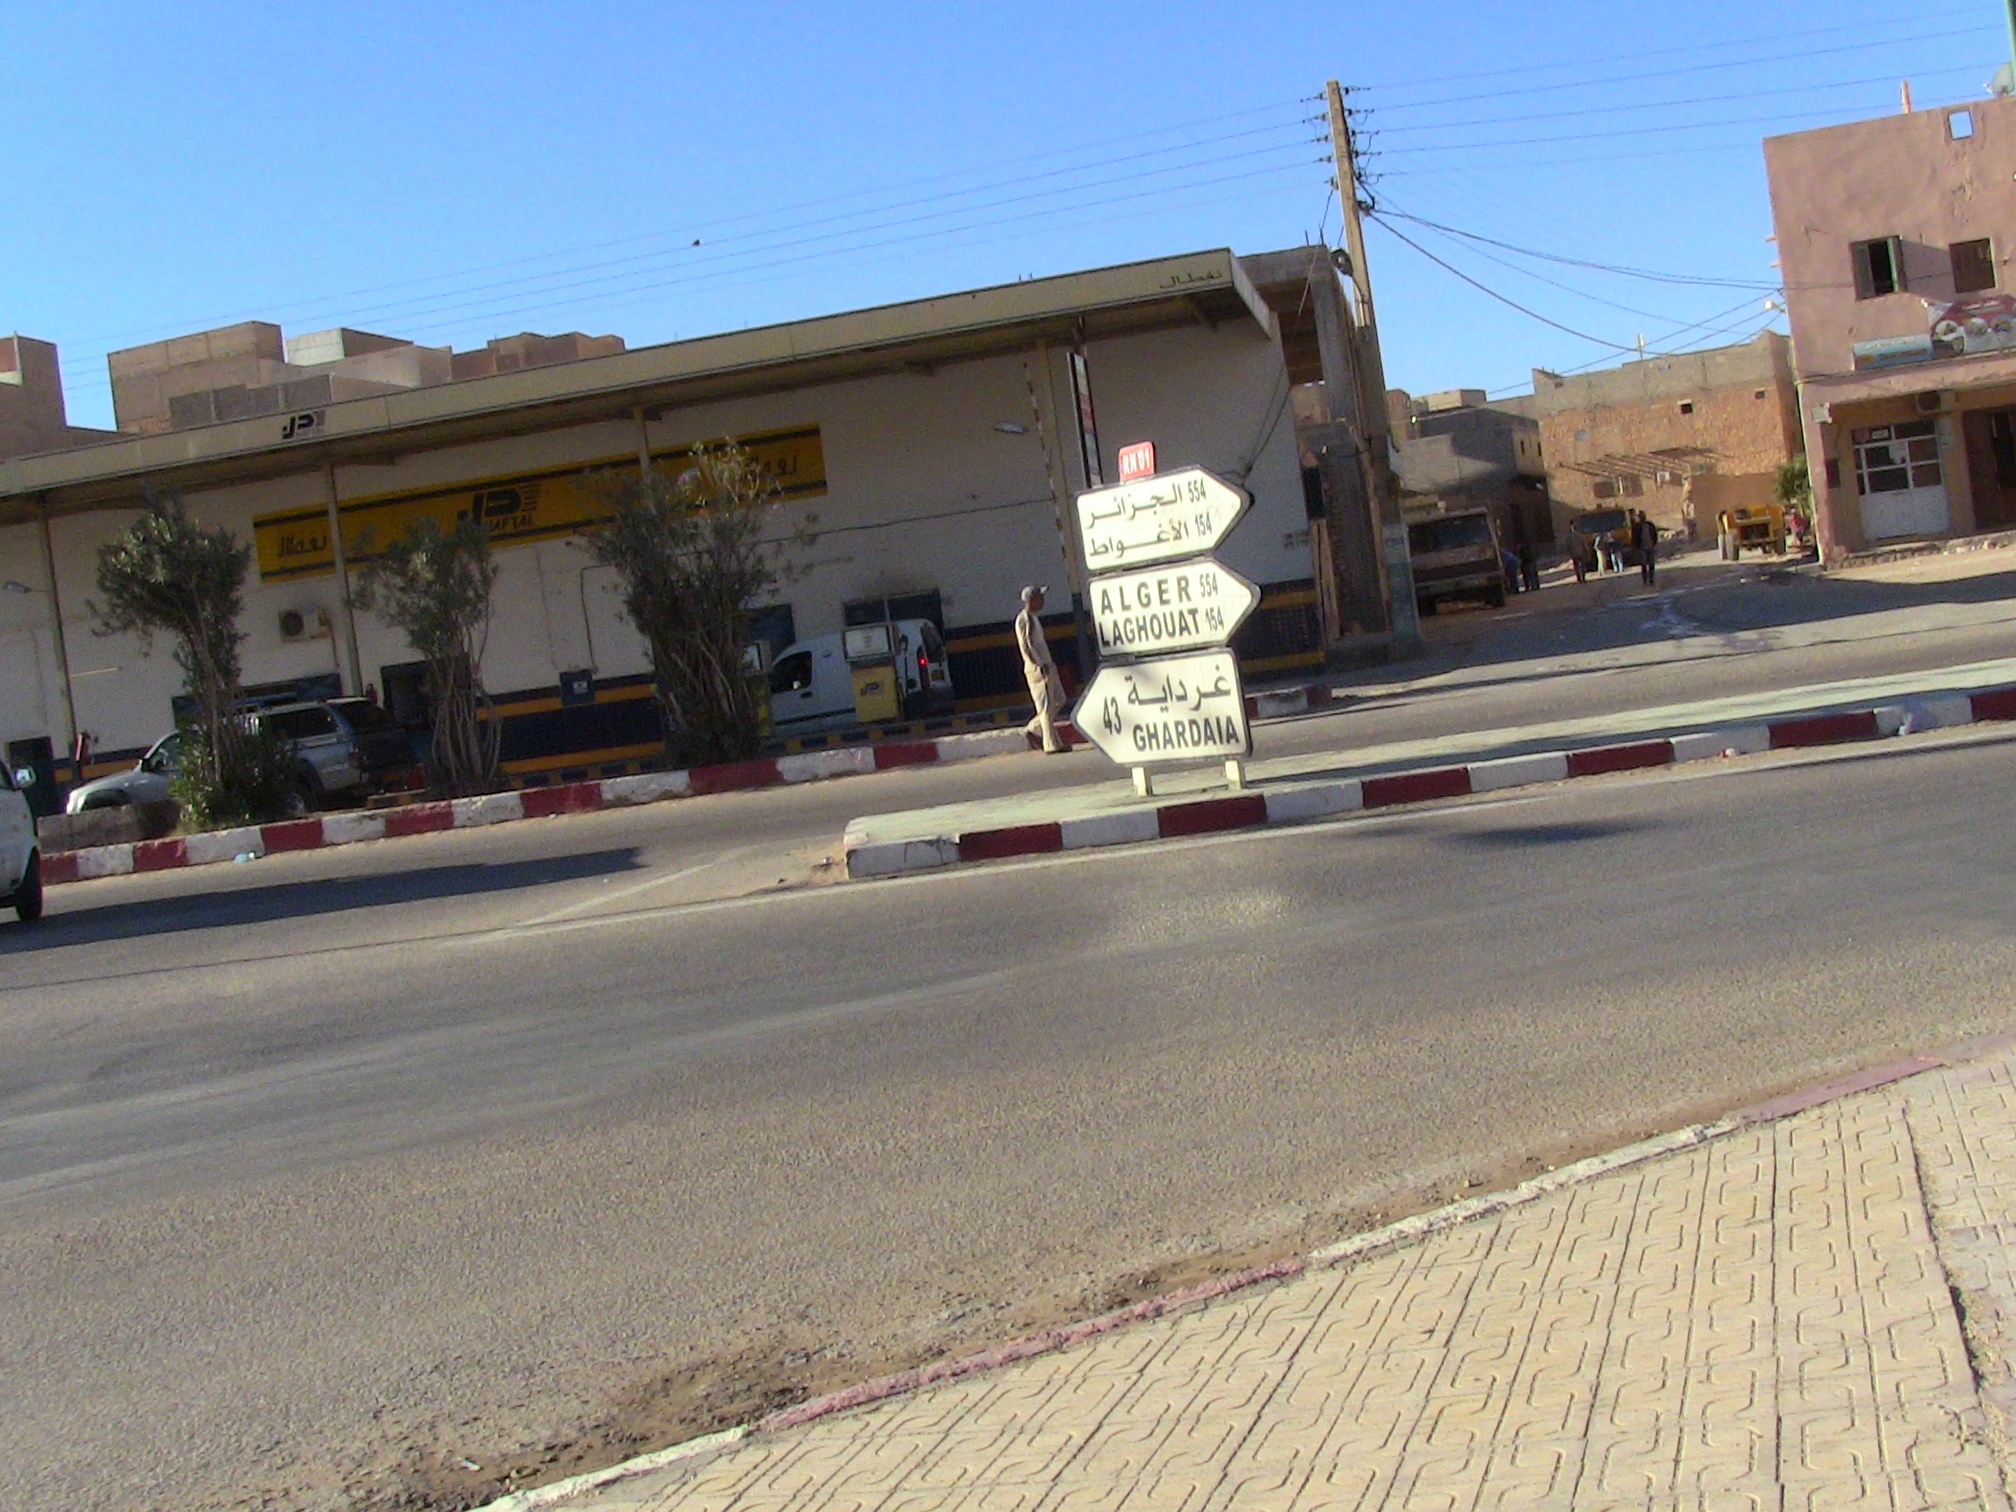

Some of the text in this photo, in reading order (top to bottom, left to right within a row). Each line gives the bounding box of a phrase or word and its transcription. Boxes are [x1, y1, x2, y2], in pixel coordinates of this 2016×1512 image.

[1085, 477, 1206, 530] الجزائر 554
[1089, 510, 1213, 559] الأغواط 154
[1101, 572, 1218, 615] ALGER 554
[1098, 605, 1224, 648] LAGHOUAT 154
[1124, 664, 1231, 713] غرداية
[1103, 696, 1122, 735] 43
[1133, 715, 1240, 751] GHARDAIA
